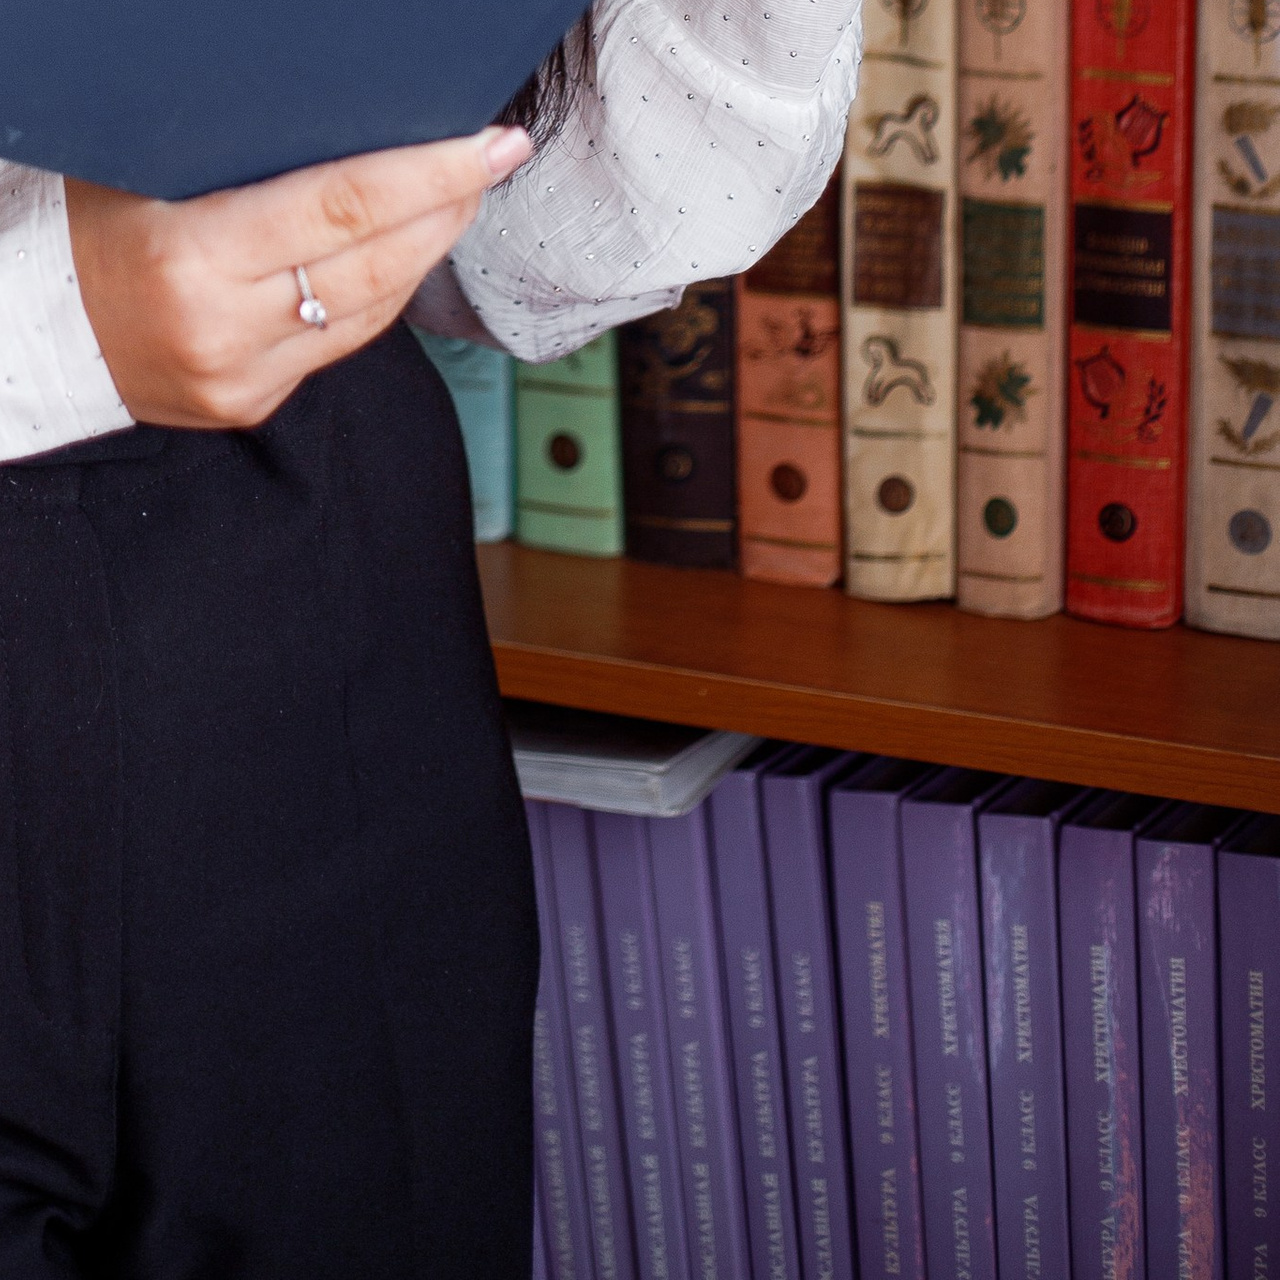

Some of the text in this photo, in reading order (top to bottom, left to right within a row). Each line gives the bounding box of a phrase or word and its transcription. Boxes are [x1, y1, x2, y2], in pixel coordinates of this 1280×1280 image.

[792, 951, 813, 1015] КЛАСС
[934, 918, 959, 1056] ХРЕСТОМАТИЯ
[1090, 942, 1111, 1083] ХРЕСТОМАТИЯ
[1169, 956, 1189, 1096] ХРЕСТОМАТИЯ
[1247, 969, 1266, 1110] ХРЕСТОМАТИЯ
[681, 1040, 706, 1148] КУЛЬТУРА
[751, 1050, 777, 1157] КУЛЬТУРА
[800, 1056, 825, 1163] КУЛЬТУРА
[865, 901, 901, 1274] КУЛЬТУРА 9 КЛАСС ХРЕСТОМАТИЯ
[944, 1081, 964, 1147] КЛАСС
[1011, 923, 1042, 1279] ЛЬТУРА 9 КЛАСС ХРЕСТОМАТИЯ
[948, 1151, 965, 1162] 9
[1096, 1109, 1114, 1174] КЛАСС
[1174, 1123, 1191, 1188] КЛАСС
[1251, 1136, 1269, 1202] КЛАСС
[1099, 1180, 1115, 1190] 9
[1175, 1193, 1192, 1204] 9
[1252, 1207, 1269, 1218] 9
